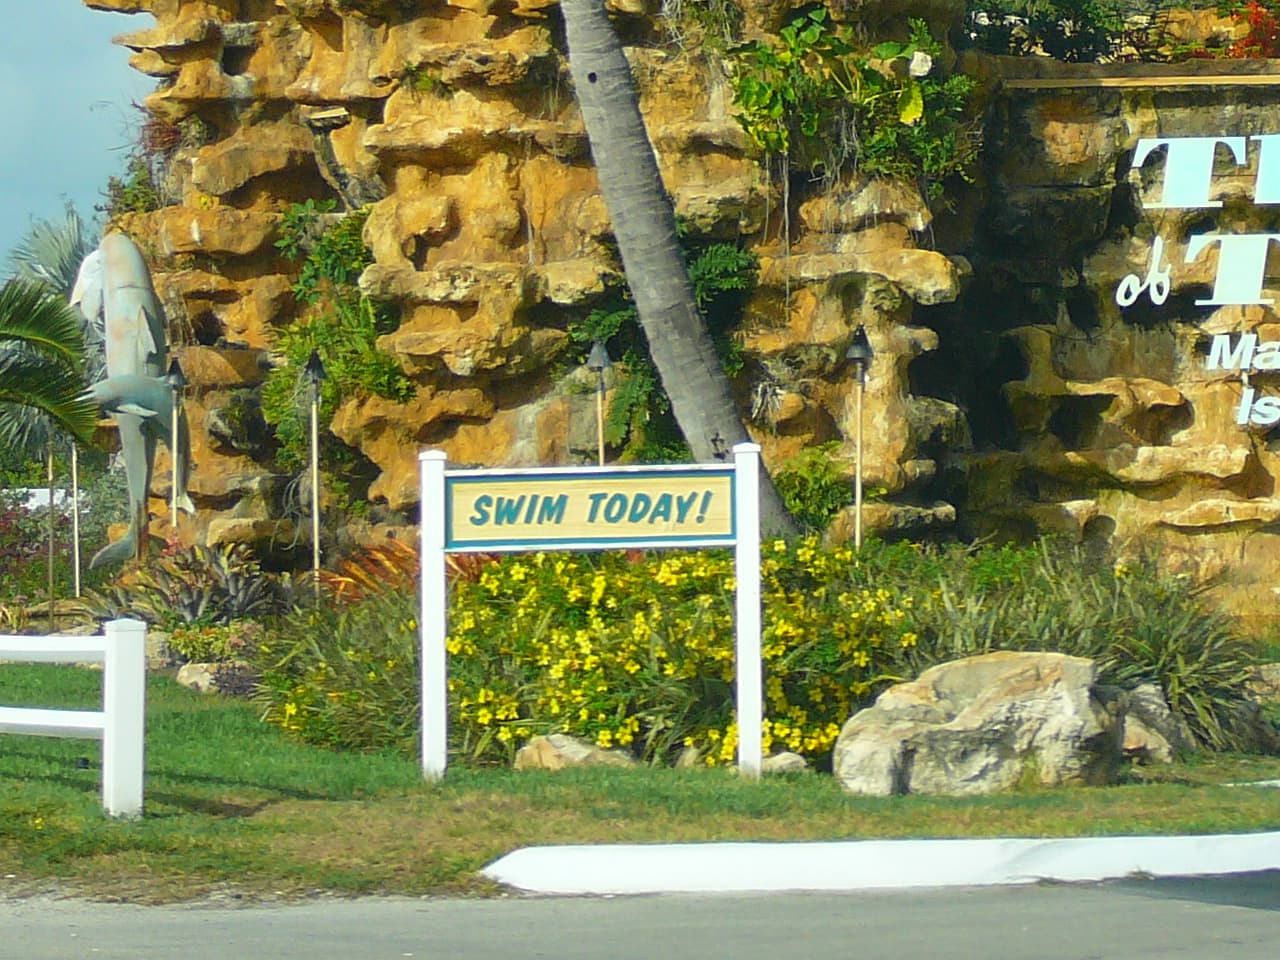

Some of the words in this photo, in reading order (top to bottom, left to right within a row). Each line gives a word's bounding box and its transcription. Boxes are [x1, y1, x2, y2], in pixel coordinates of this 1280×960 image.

[1115, 236, 1173, 307] of
[469, 494, 569, 526] SWIM
[587, 490, 713, 523] TODAY!
